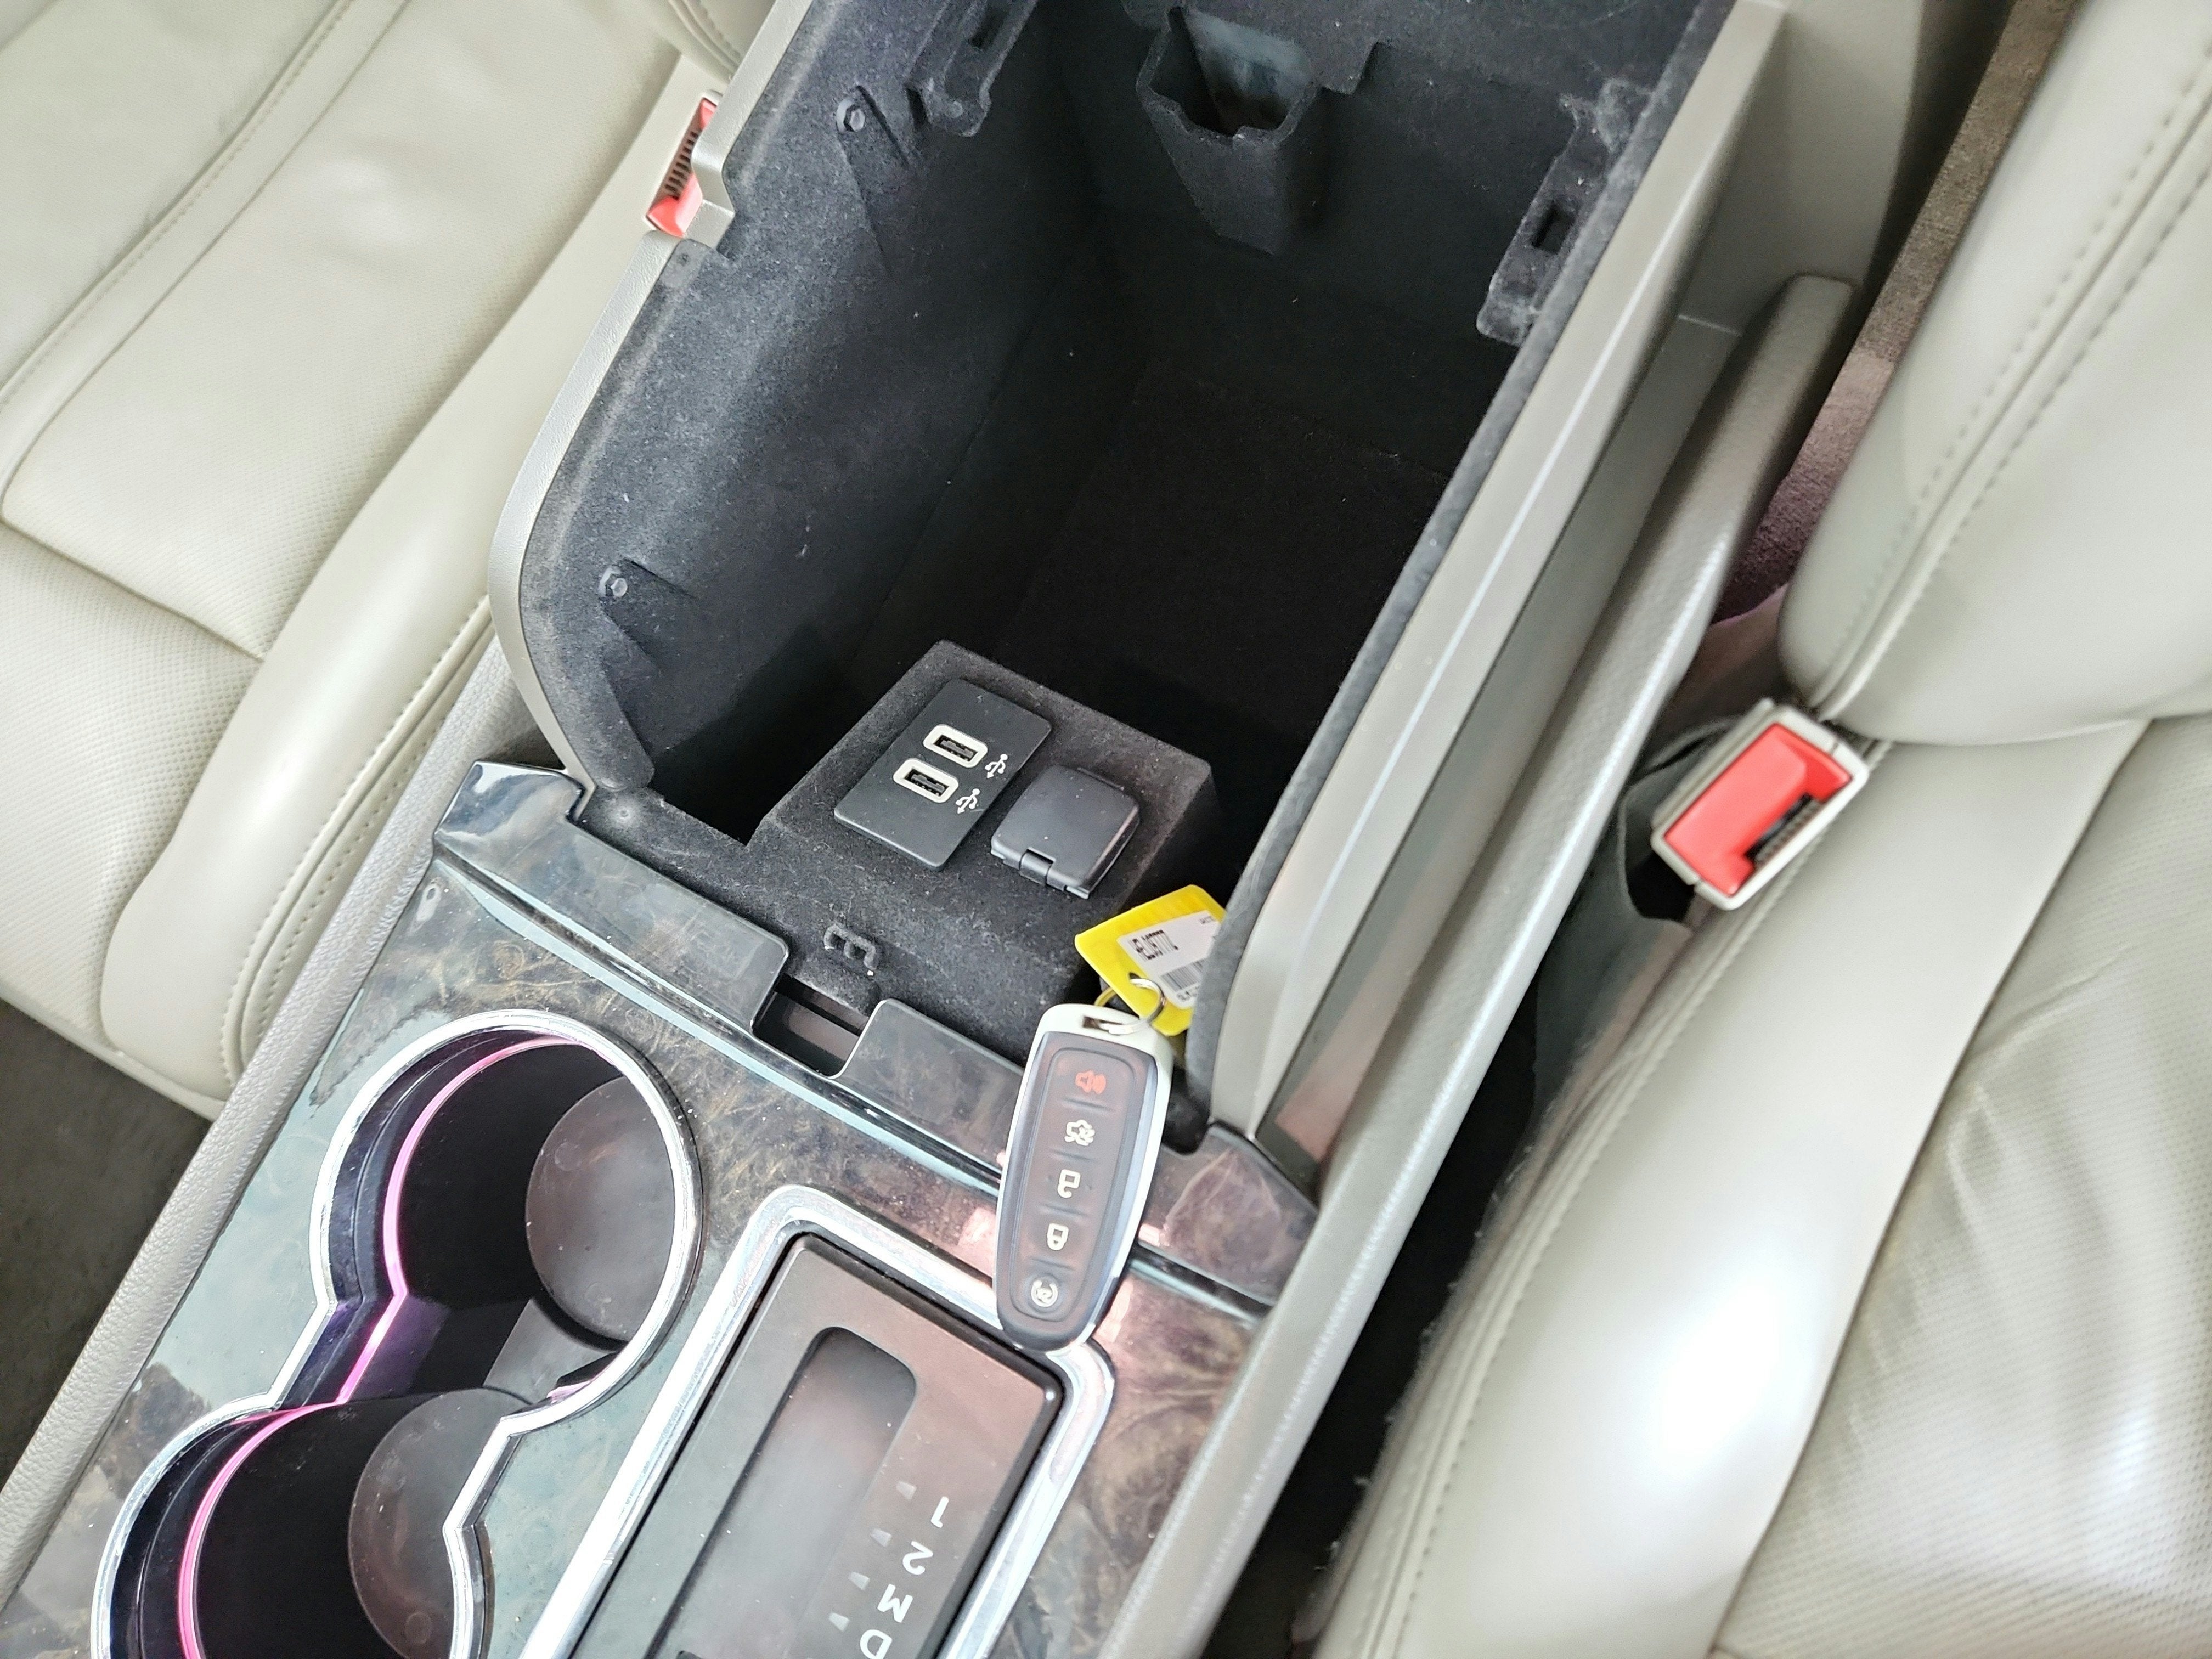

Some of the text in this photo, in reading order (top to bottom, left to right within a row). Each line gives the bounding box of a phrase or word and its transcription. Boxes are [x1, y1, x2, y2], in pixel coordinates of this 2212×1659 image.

[930, 1496, 949, 1528] 1
[902, 1541, 934, 1575] 2
[877, 1584, 913, 1623] M
[860, 1629, 893, 1659] D
